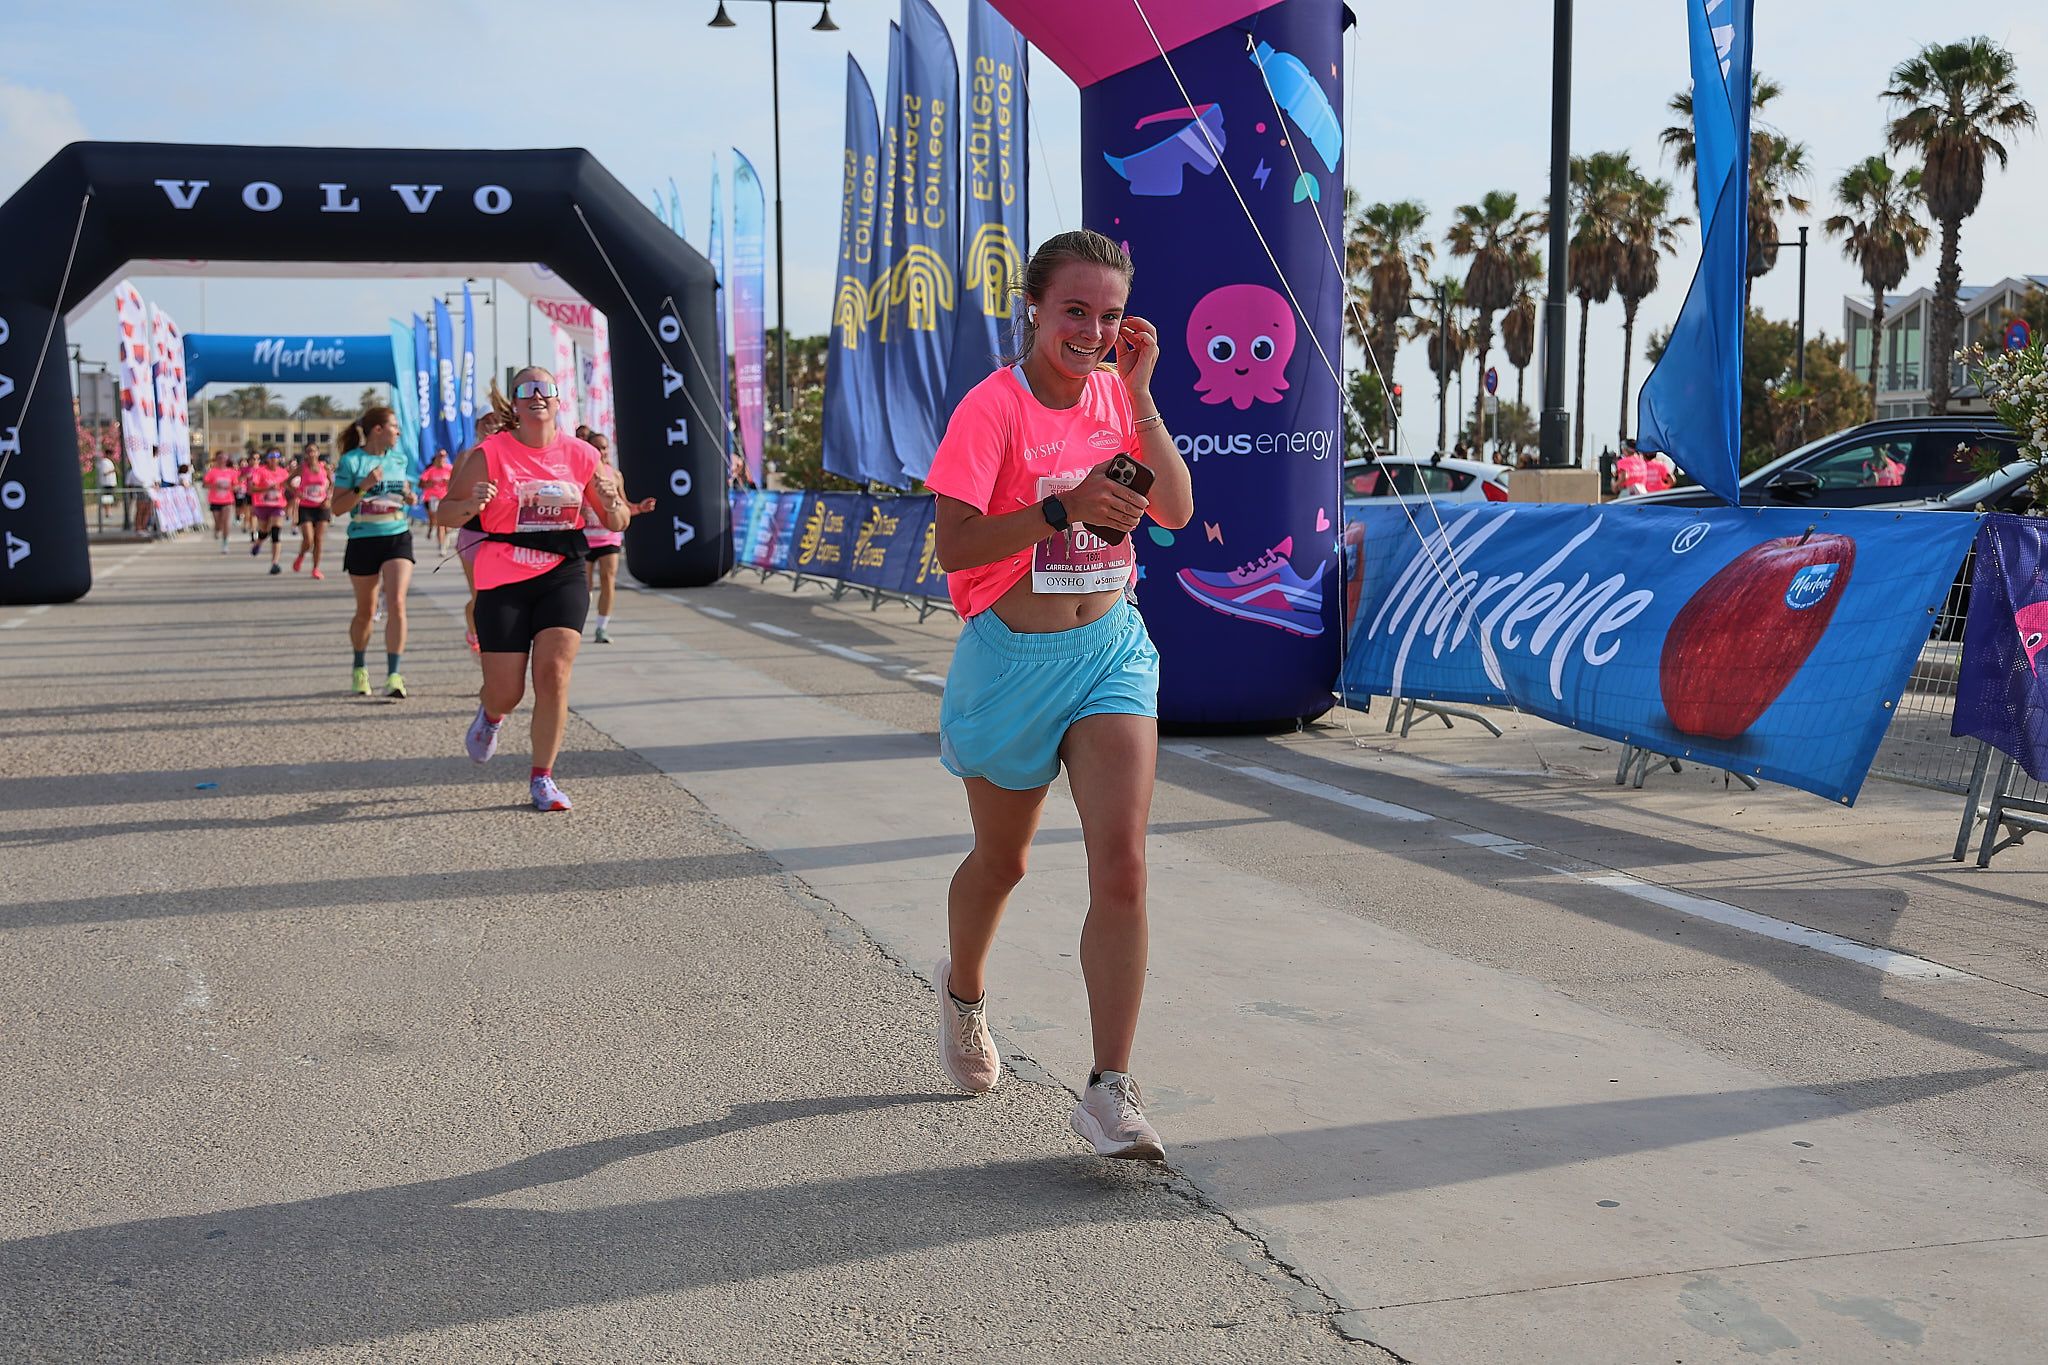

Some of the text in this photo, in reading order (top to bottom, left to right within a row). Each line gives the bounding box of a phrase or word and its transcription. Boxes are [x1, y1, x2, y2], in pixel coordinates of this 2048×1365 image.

[154, 178, 513, 215] VOLVO
[253, 338, 346, 378] Marlene
[658, 314, 696, 551] VOLVO
[1255, 430, 1334, 461] energy
[1023, 441, 1066, 461] OYSHO
[537, 505, 561, 516] 016
[1045, 563, 1073, 572] CARRERA
[1075, 564, 1083, 572] DE
[1083, 563, 1091, 571] LA
[1046, 577, 1085, 587] OYSHO
[1789, 574, 1832, 599] Marlene
[1368, 509, 1654, 698] Marlene
